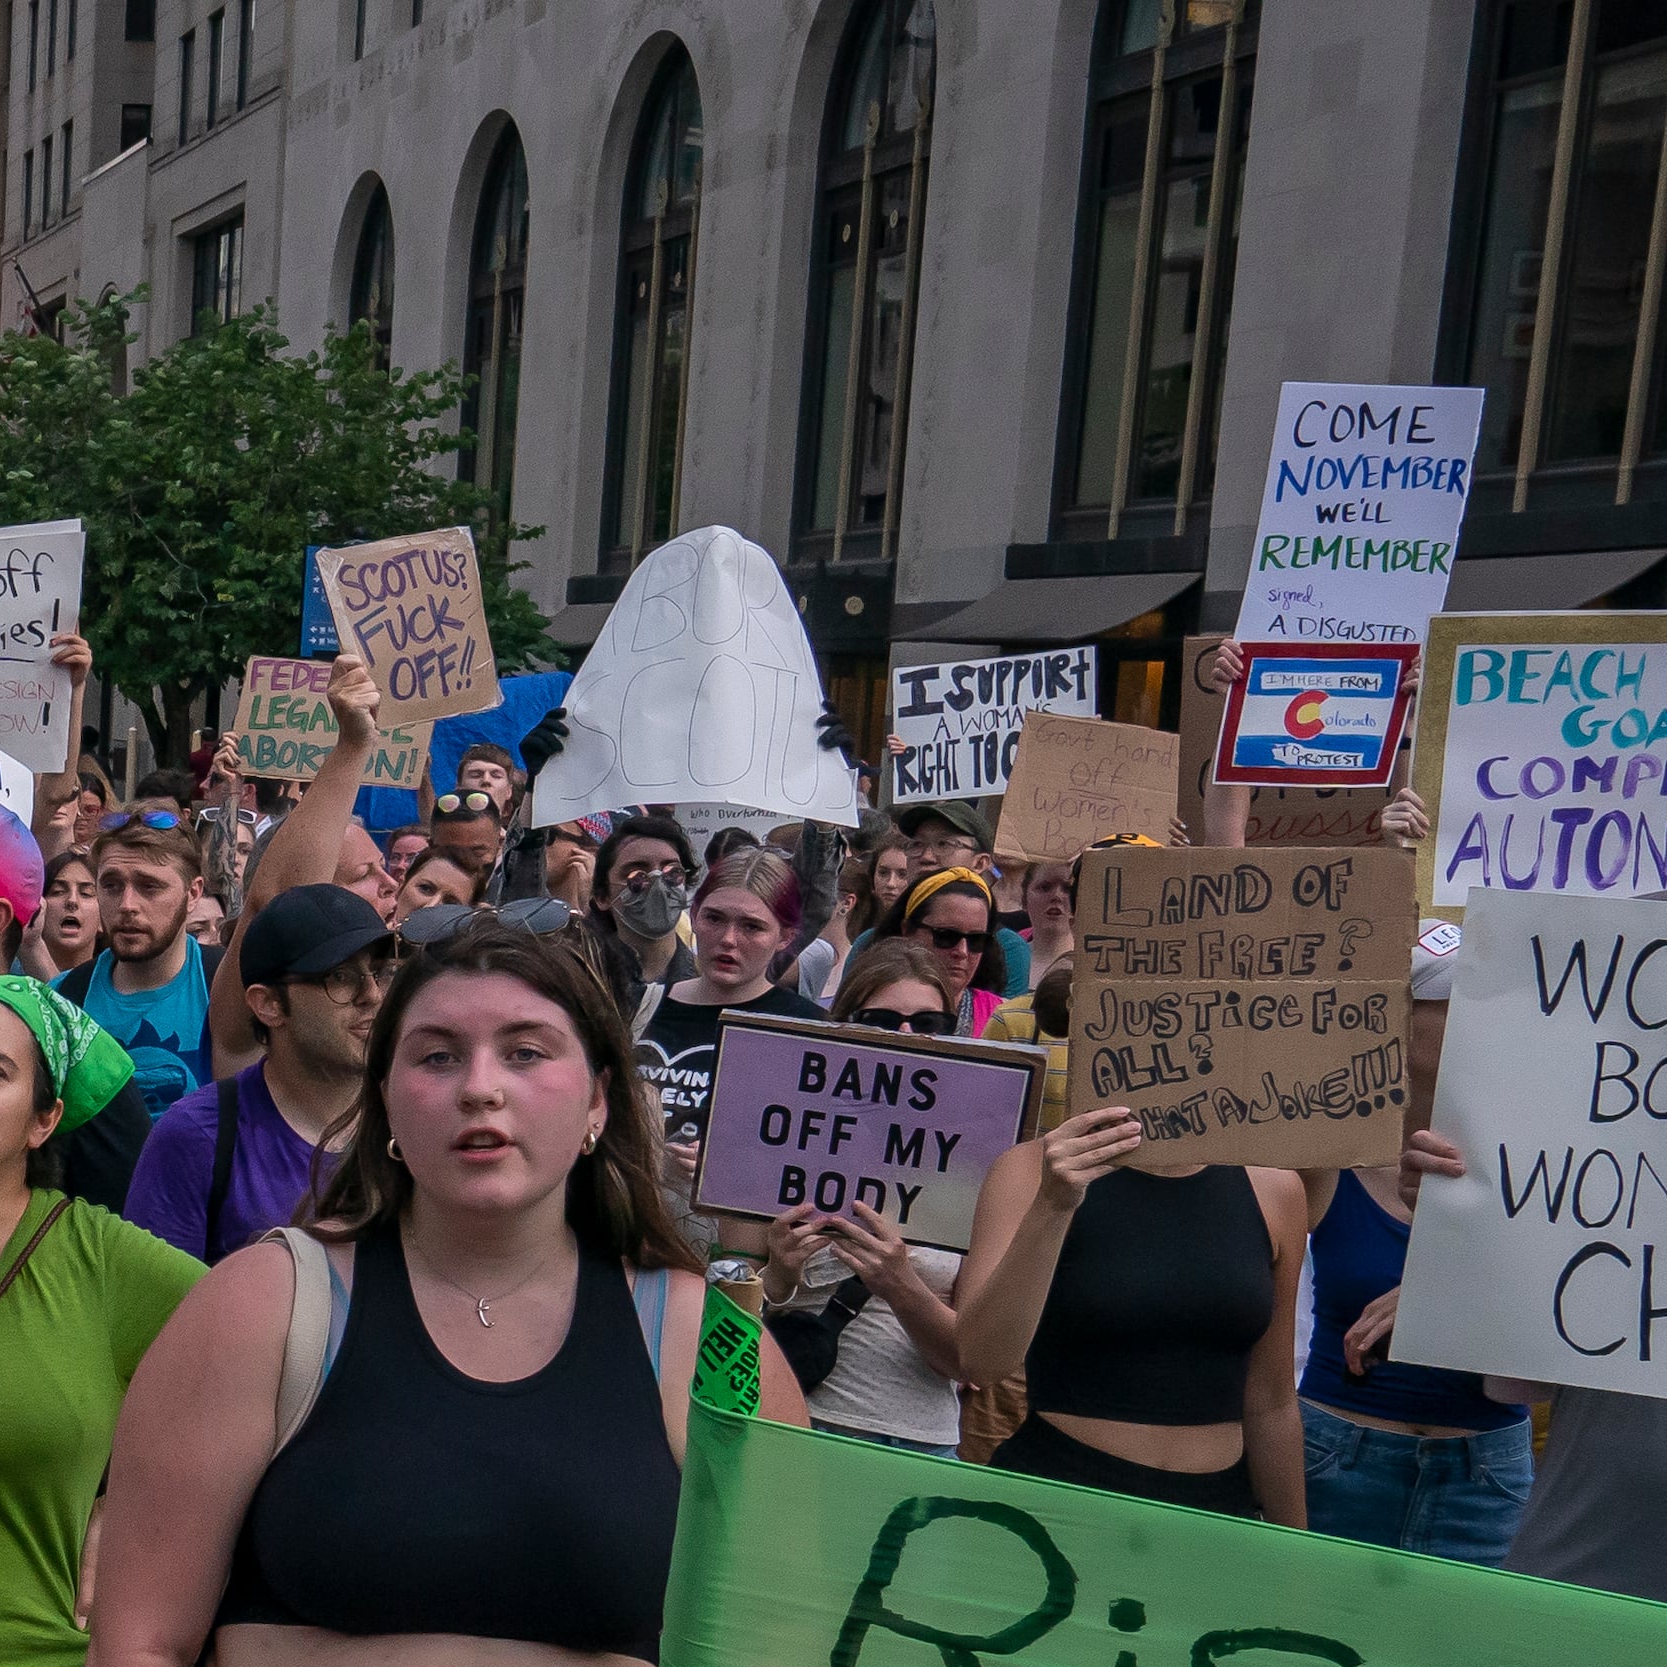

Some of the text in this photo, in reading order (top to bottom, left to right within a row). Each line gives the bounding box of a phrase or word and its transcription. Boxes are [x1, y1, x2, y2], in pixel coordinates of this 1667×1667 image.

[1294, 400, 1435, 449] COME
[1275, 453, 1467, 503] NOVEMBER
[1316, 496, 1391, 523] WE'LL
[339, 549, 468, 612] SCOTUS?
[1258, 534, 1452, 576] REMEMBER
[353, 594, 465, 668] FUCK
[1268, 614, 1418, 644] A DISGUSTED
[250, 659, 332, 694] FEDE
[389, 636, 476, 701] OFF!!
[898, 666, 945, 718] I
[1296, 674, 1333, 687] HERE
[1339, 675, 1381, 691] FROM
[1455, 649, 1647, 706] BEACH
[933, 722, 952, 742] A
[1280, 745, 1362, 768] TO PROTEST
[896, 738, 961, 796] RIGHT
[1103, 857, 1353, 928] LAND OF
[1084, 935, 1186, 975] THE
[798, 1051, 939, 1112] BANS
[1091, 1033, 1215, 1098] ALL?
[759, 1104, 963, 1173] OFF MY
[1139, 1090, 1209, 1142] HAT
[777, 1164, 924, 1225] BODY
